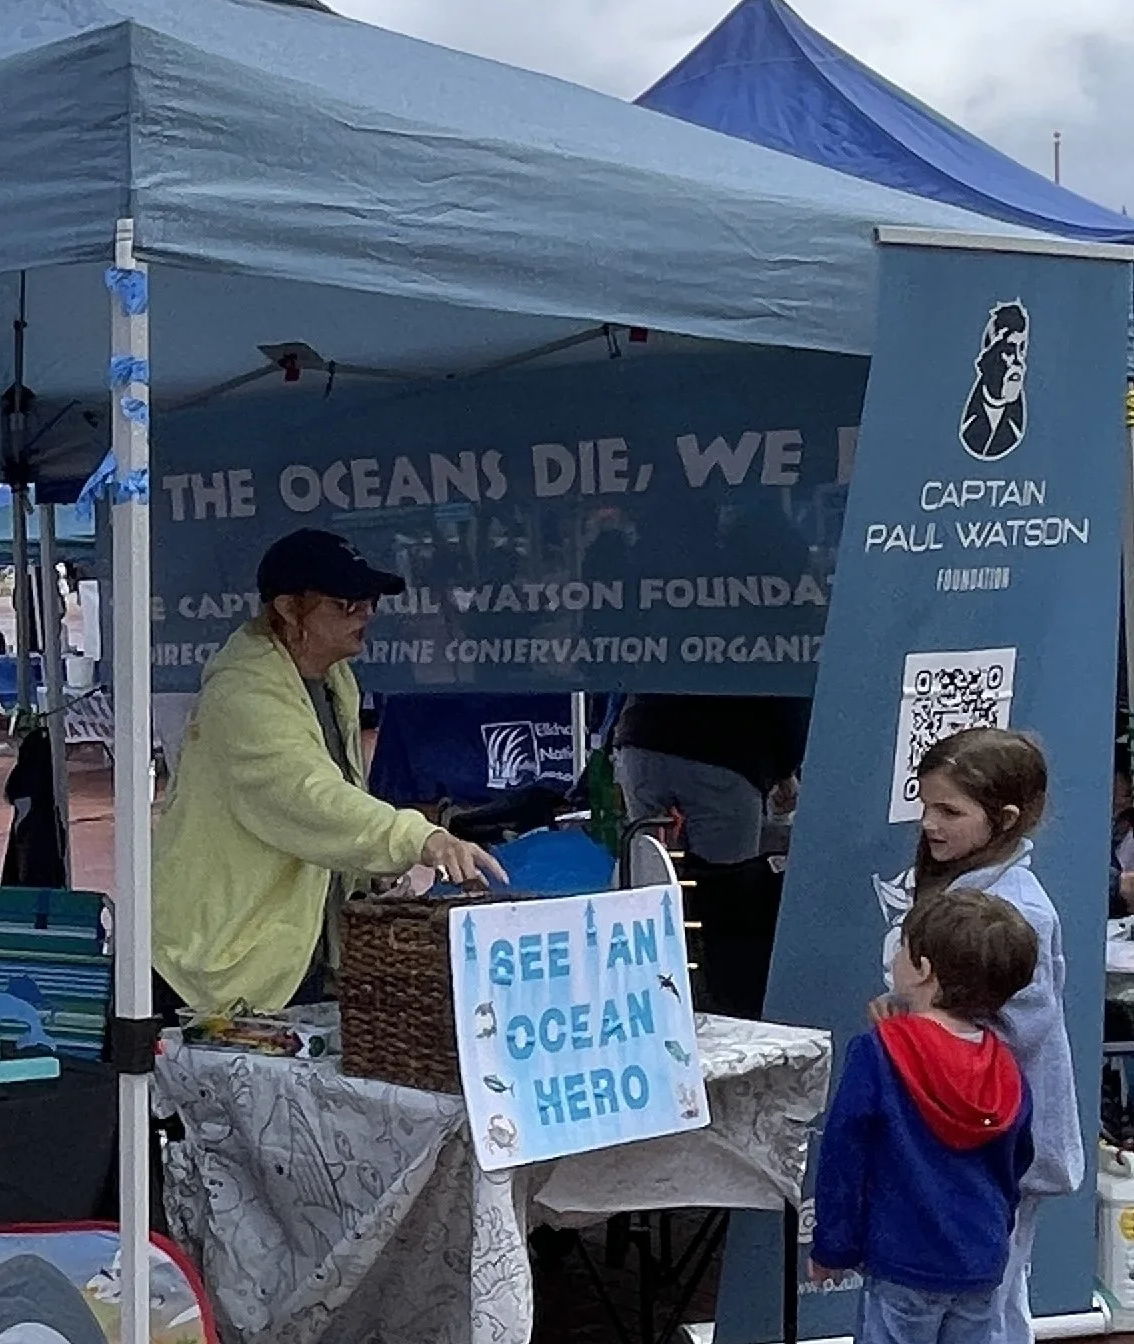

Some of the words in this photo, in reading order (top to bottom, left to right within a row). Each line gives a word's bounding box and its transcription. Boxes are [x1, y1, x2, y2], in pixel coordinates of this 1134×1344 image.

[163, 469, 256, 522] THE
[280, 449, 507, 512] OCEANS
[532, 438, 654, 497] DIE,
[677, 430, 803, 487] WE
[921, 480, 1047, 511] CAPTAIN
[865, 522, 944, 553] PAUL
[955, 517, 1091, 549] WATSON
[178, 592, 261, 619] CAPT
[377, 586, 441, 614] AUL
[452, 580, 625, 613] WATSON
[639, 574, 833, 609] FOUNDA
[936, 567, 1011, 592] FOUNDATION
[355, 640, 435, 665] ARINE
[444, 636, 668, 665] CONSERVATION
[680, 635, 824, 664] ORGANIZ
[535, 722, 589, 737] Elkho
[489, 930, 570, 986] SEE
[606, 918, 658, 969] AN
[506, 989, 656, 1060] OCEAN
[533, 1064, 650, 1126] HERO
